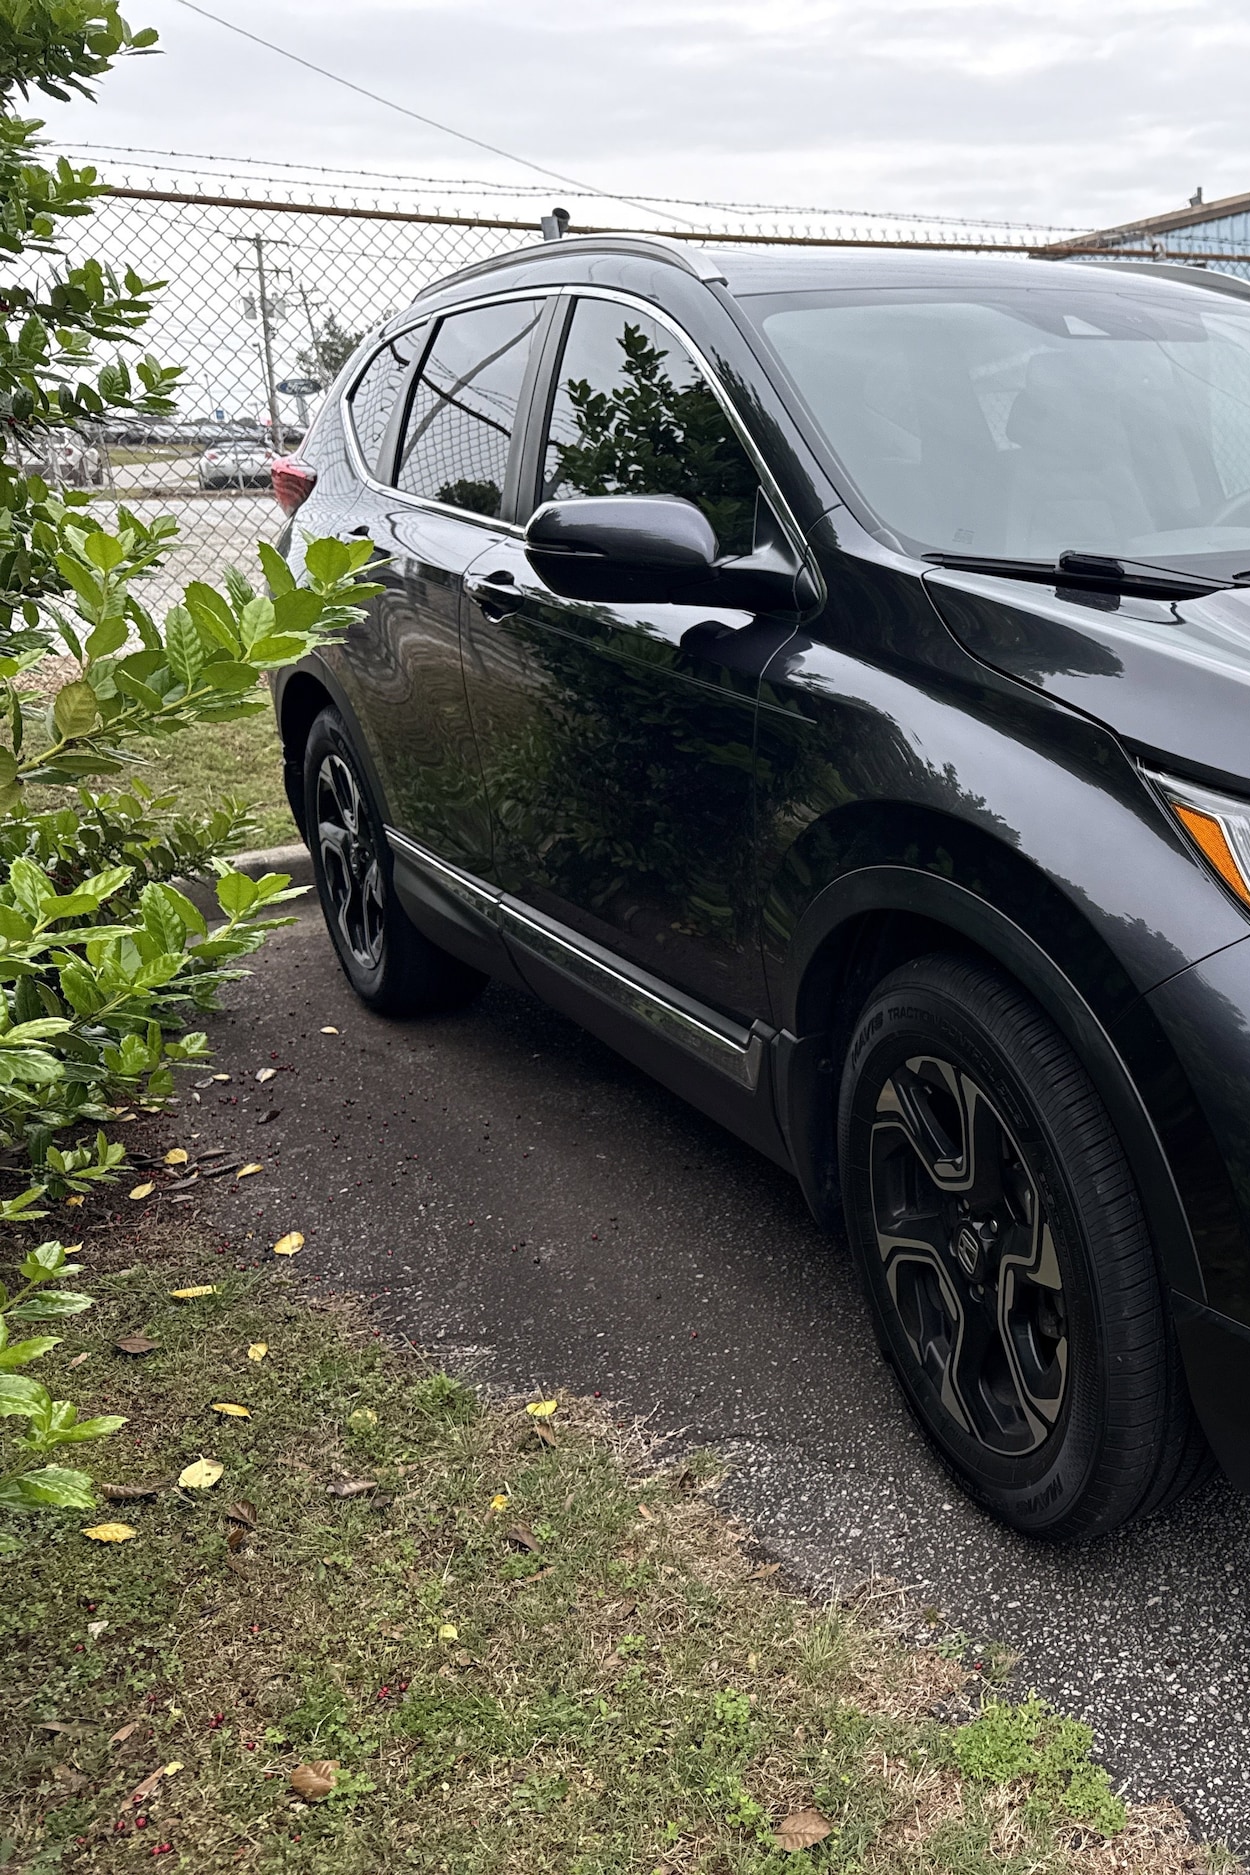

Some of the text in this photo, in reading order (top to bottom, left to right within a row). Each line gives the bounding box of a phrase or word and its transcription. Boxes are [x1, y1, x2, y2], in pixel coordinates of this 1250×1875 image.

[851, 1010, 883, 1070] MAVIS
[887, 1006, 938, 1027] TRACTION
[1016, 1473, 1065, 1514] MAVIS
